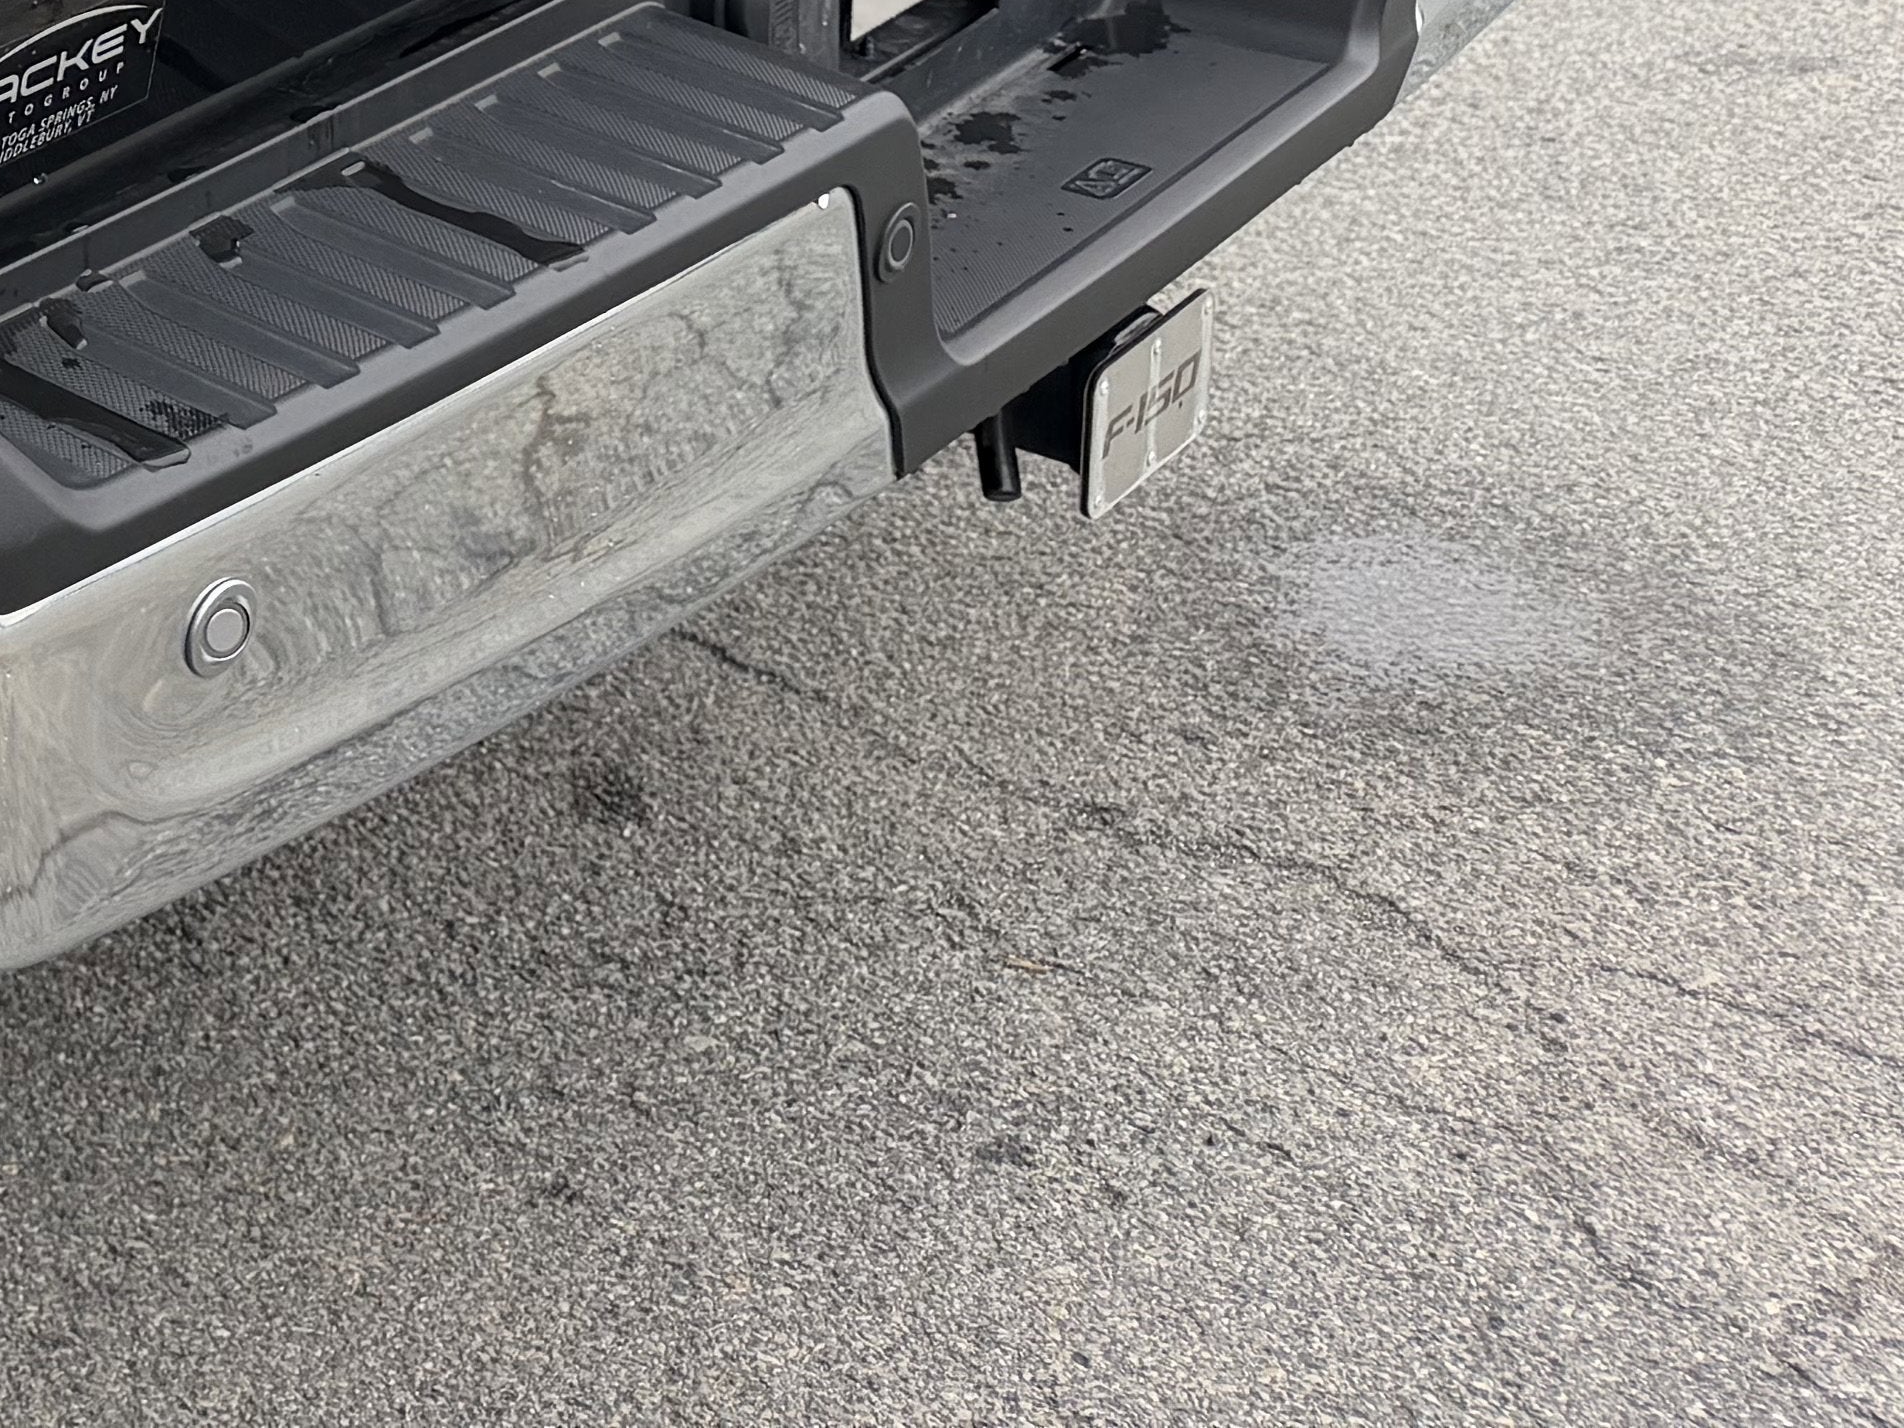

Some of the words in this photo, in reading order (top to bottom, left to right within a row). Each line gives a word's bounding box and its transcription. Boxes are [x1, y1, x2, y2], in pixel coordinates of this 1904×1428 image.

[99, 84, 119, 105] NY
[77, 108, 95, 127] VT
[1102, 349, 1202, 460] F-150
